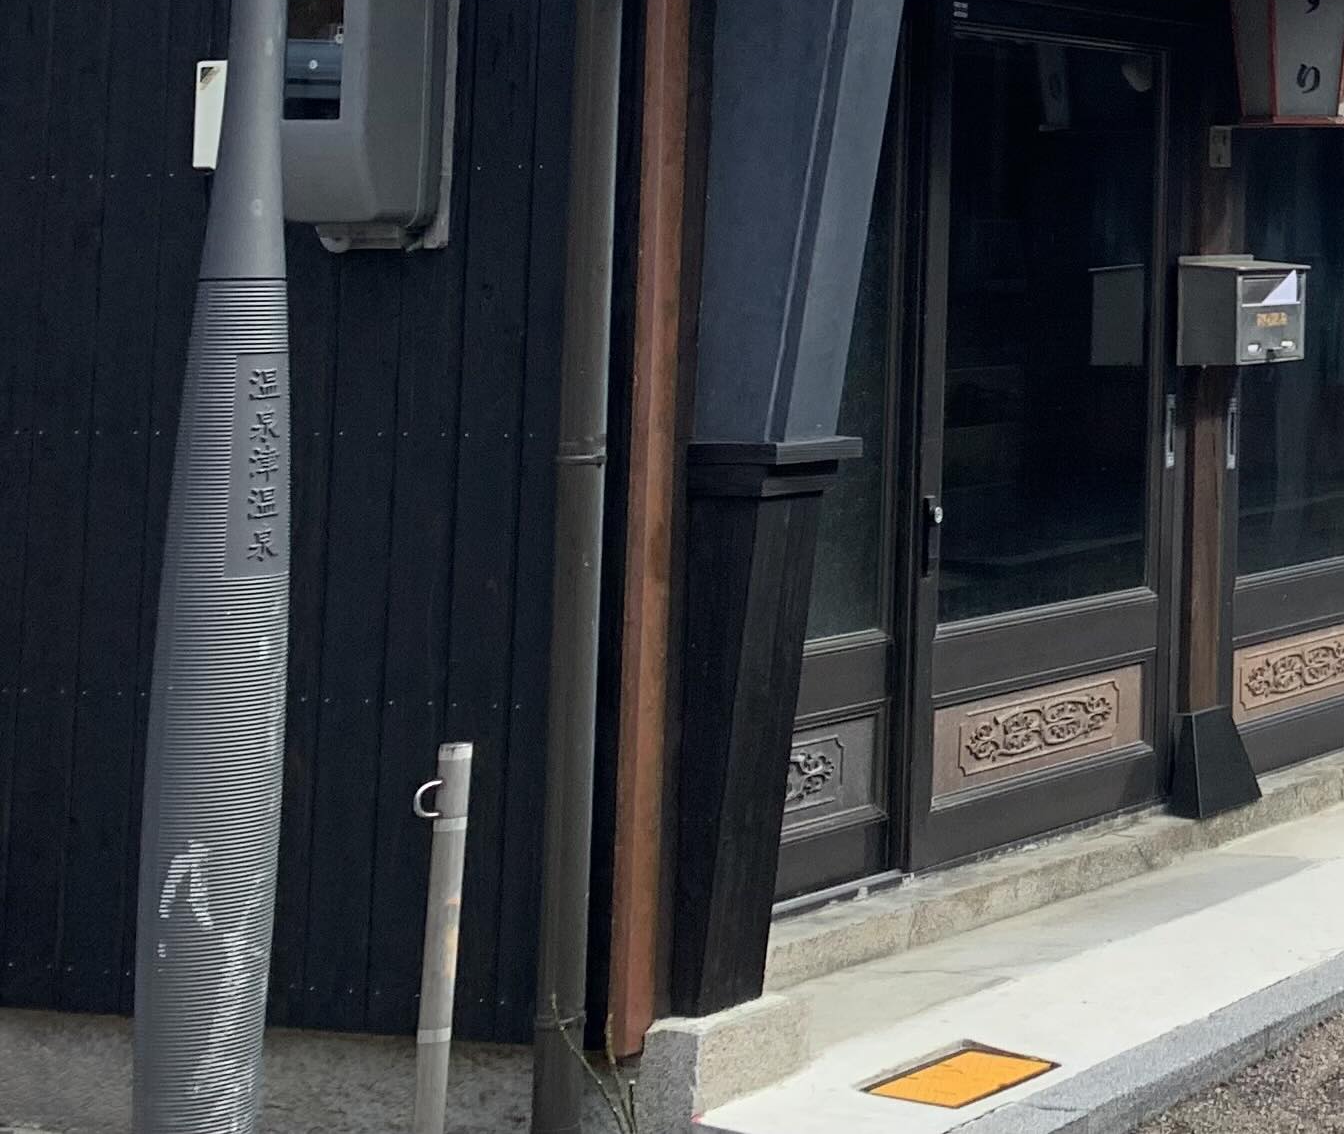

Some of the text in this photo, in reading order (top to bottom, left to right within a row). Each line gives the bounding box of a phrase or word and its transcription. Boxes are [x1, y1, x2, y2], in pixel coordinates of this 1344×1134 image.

[247, 368, 281, 562] 温泉津温泉
